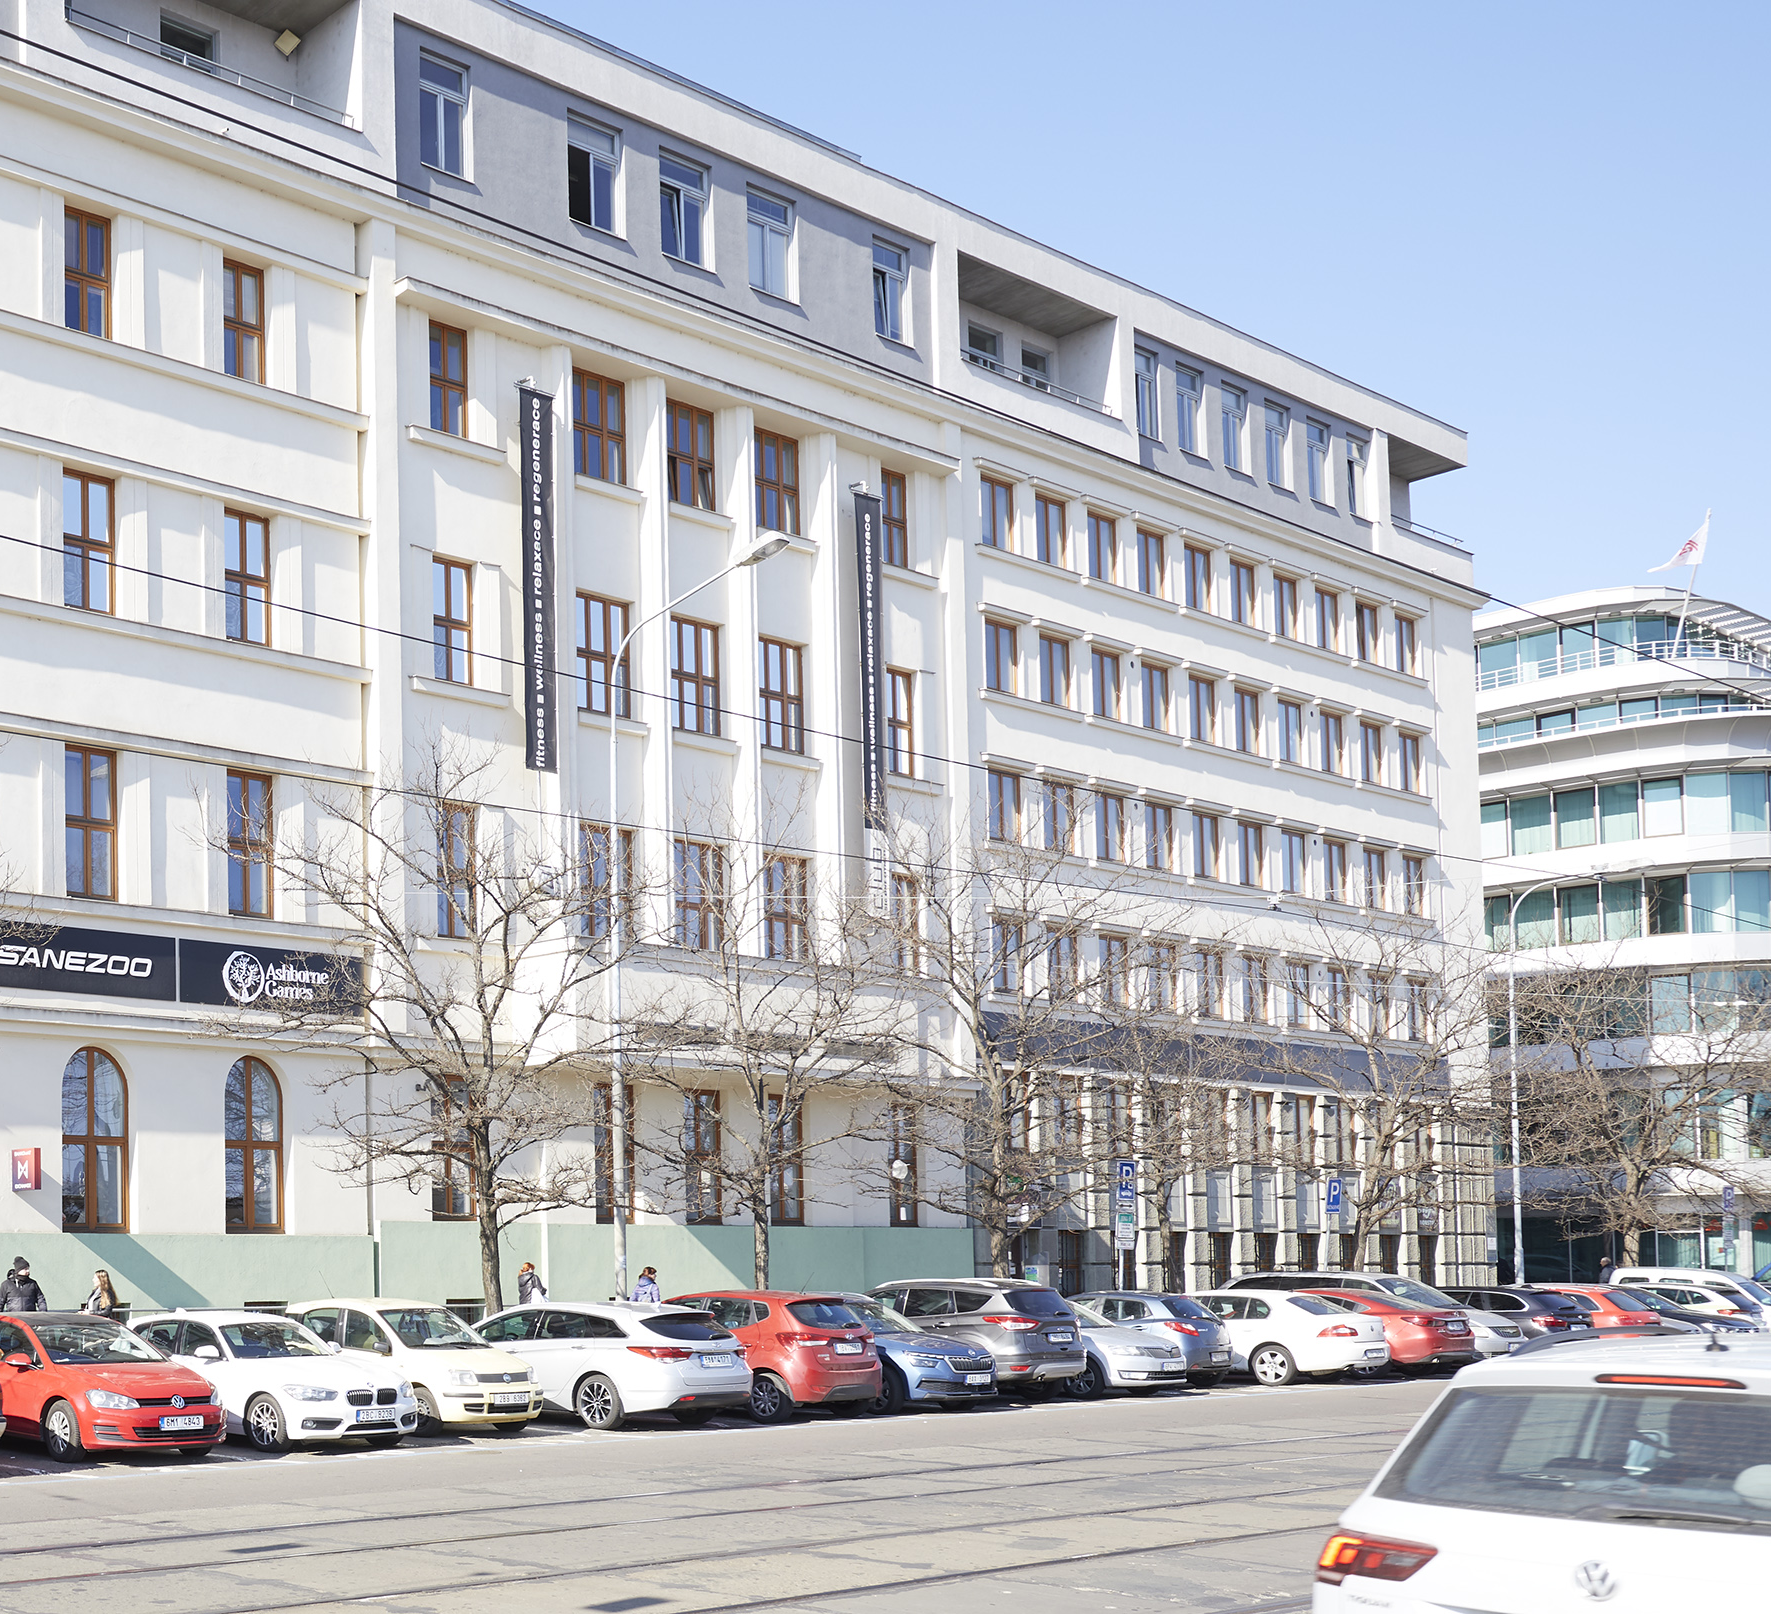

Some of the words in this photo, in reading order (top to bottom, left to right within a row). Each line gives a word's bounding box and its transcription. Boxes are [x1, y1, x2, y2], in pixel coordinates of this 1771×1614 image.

[532, 397, 542, 502] regenerace
[532, 518, 543, 596] relaxace
[534, 612, 545, 691] wellness
[535, 706, 546, 768] fitness
[264, 980, 314, 1000] Games
[265, 962, 329, 985] Ashborne
[1330, 1182, 1340, 1203] P
[183, 1416, 201, 1426] 4843
